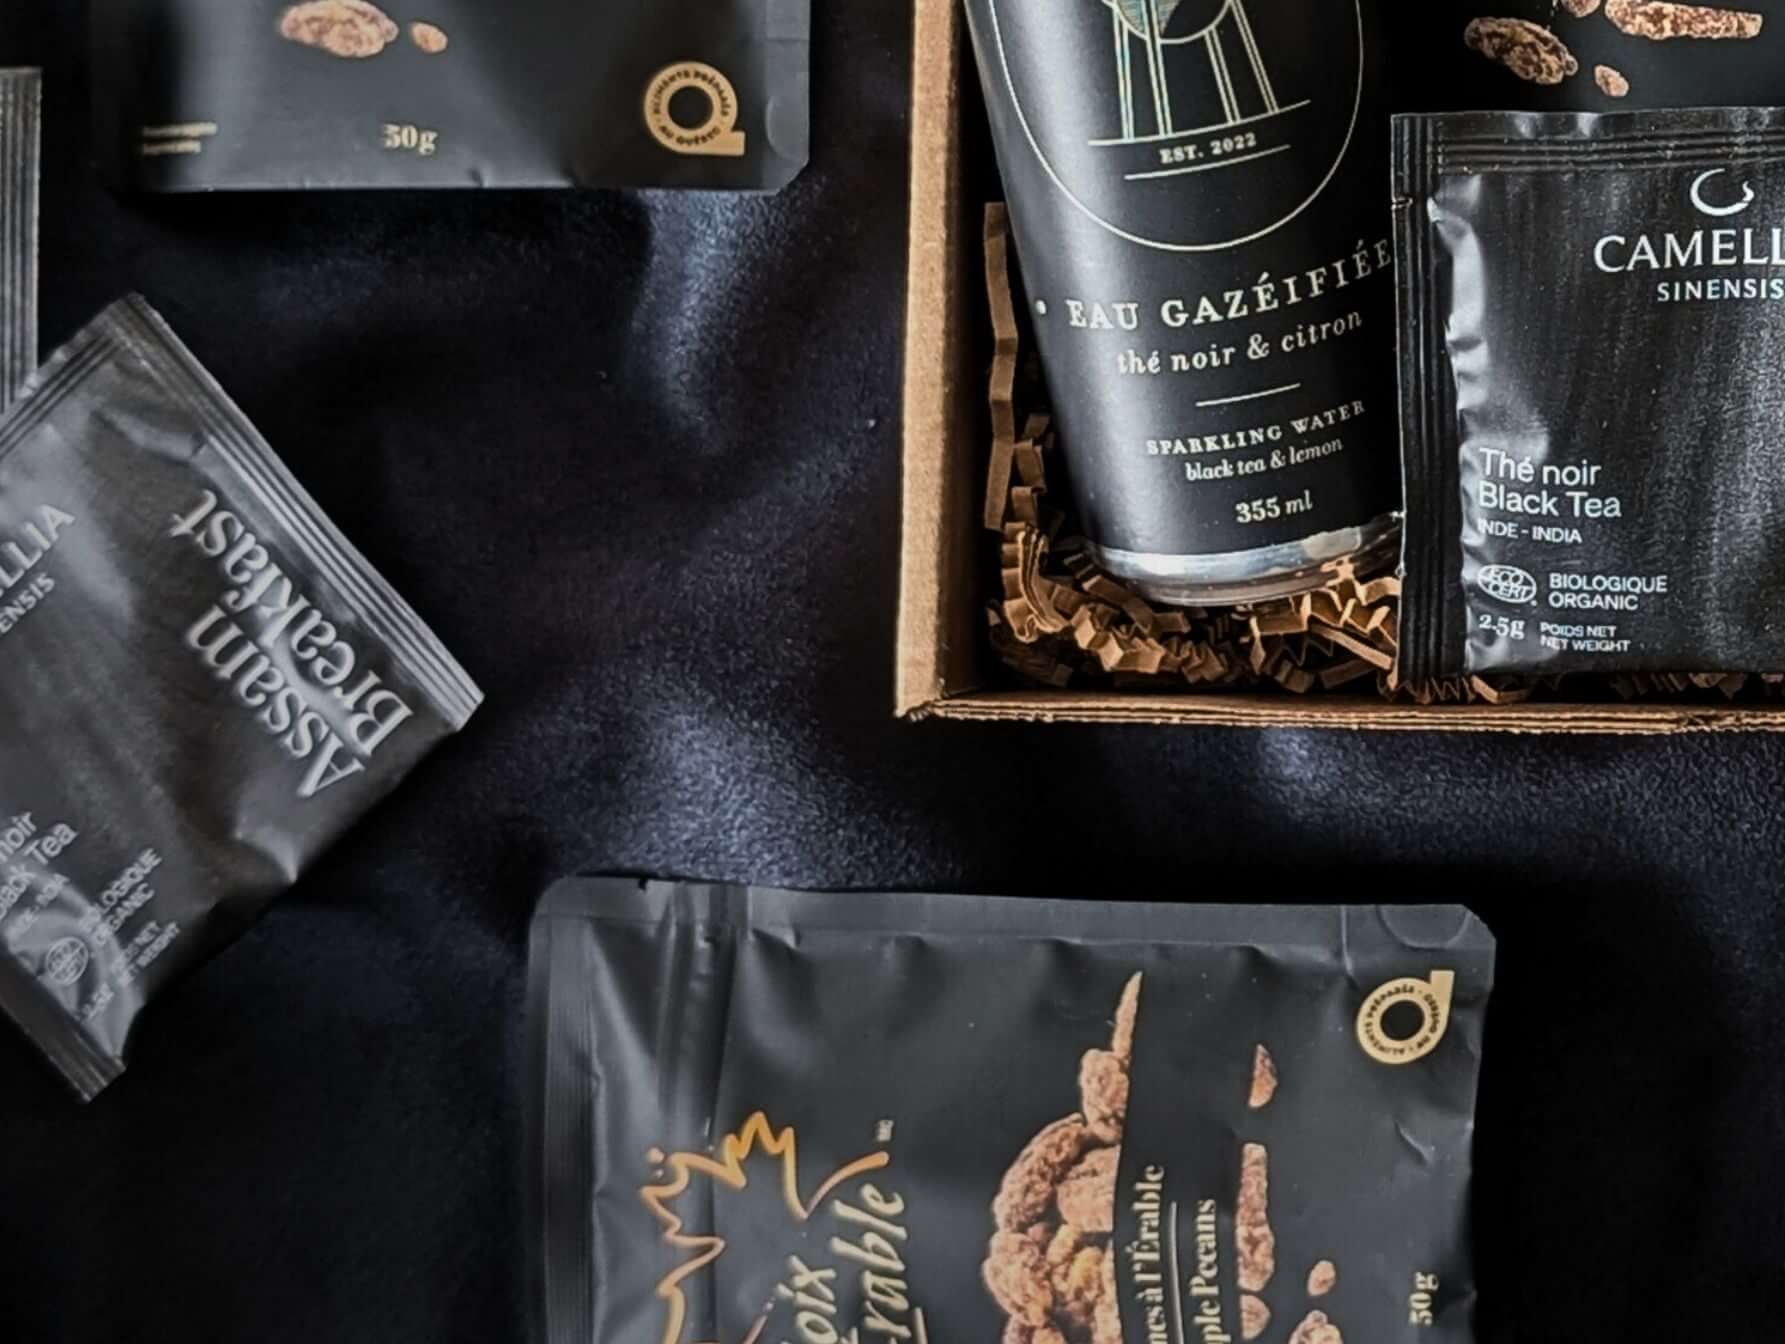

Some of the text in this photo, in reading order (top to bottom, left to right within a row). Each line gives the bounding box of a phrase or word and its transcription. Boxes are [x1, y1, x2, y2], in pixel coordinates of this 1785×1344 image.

[1159, 132, 1257, 165] EST. 2022
[1065, 237, 1393, 331] EAU GAZÉIFIÉE
[1117, 308, 1363, 376] thé noir & citron
[1146, 399, 1366, 457] SPARKLING WATER
[1185, 436, 1344, 482] black tea & lemon
[1478, 447, 1601, 487] Thé noir
[1234, 490, 1314, 524] 355 ml
[1478, 482, 1622, 519] Black Tea
[1477, 519, 1583, 545] INDE INDIA
[1548, 591, 1639, 610] ORGANIC
[1549, 572, 1668, 595] BIOLOGIQUE
[167, 488, 414, 757] Breakfast
[1479, 613, 1525, 640] 2.5g
[1540, 622, 1617, 637] POIDS NET
[1540, 636, 1631, 652] NET WEIGHT
[187, 604, 366, 796] Assam
[23, 823, 79, 865] Tea
[1190, 1199, 1218, 1296] Pecans
[1408, 1272, 1441, 1326] 50g
